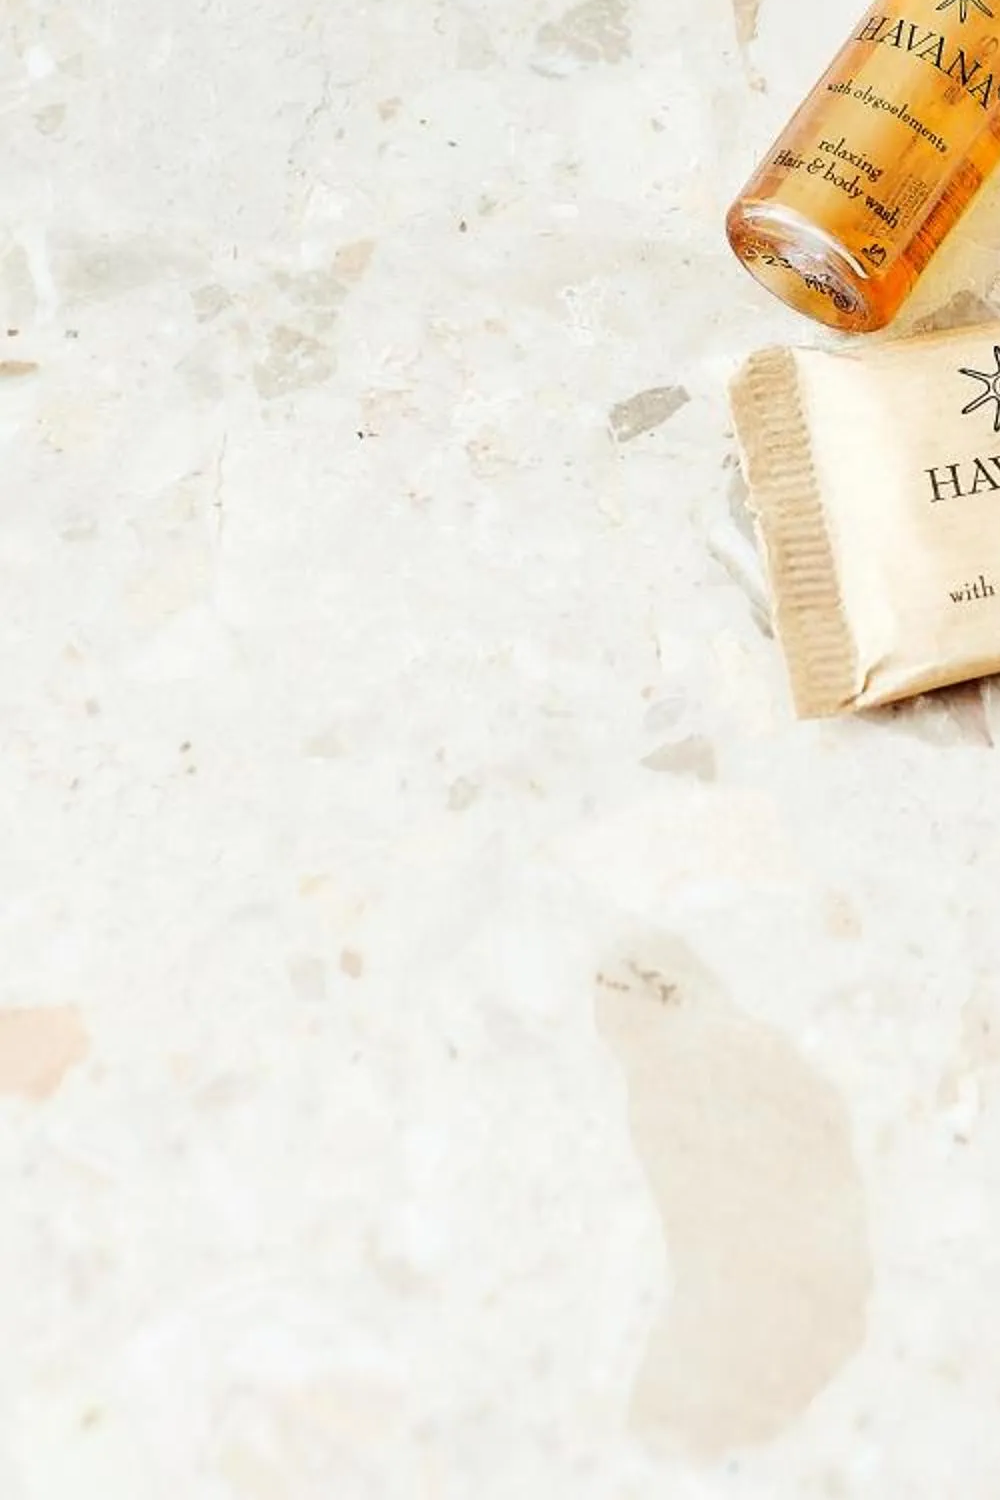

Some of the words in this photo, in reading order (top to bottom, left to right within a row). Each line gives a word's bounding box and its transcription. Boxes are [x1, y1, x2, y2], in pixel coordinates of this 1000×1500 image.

[827, 81, 853, 97] with
[853, 85, 948, 154] olygoelements
[772, 149, 805, 169] Hair
[807, 157, 825, 175] &
[822, 161, 864, 200] body
[865, 195, 900, 229] wash
[818, 138, 882, 184] relaxing
[949, 575, 996, 604] with
